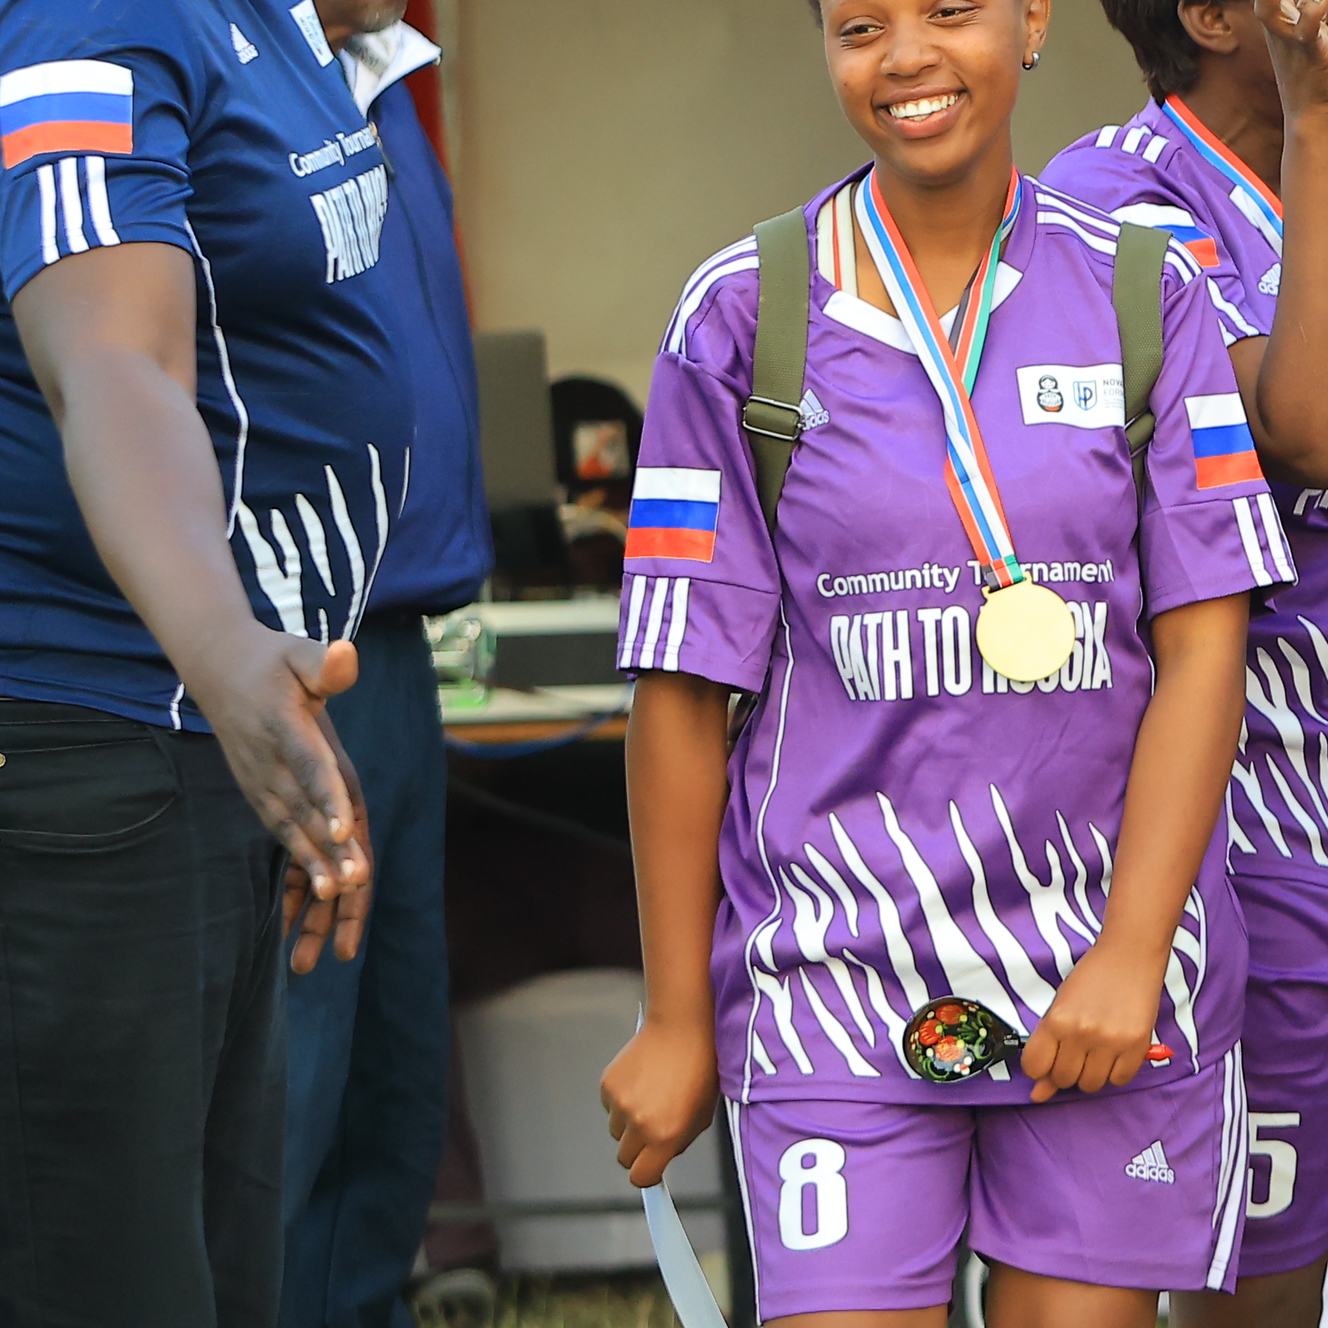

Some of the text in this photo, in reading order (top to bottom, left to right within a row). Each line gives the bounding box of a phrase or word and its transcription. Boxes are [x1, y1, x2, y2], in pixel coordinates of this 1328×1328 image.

[817, 559, 1116, 598] Community Trnament
[830, 609, 914, 701] PATH
[917, 605, 973, 697] TO
[778, 1138, 848, 1250] 8
[1125, 1163, 1176, 1184] adidas
[1245, 1112, 1301, 1219] 5
